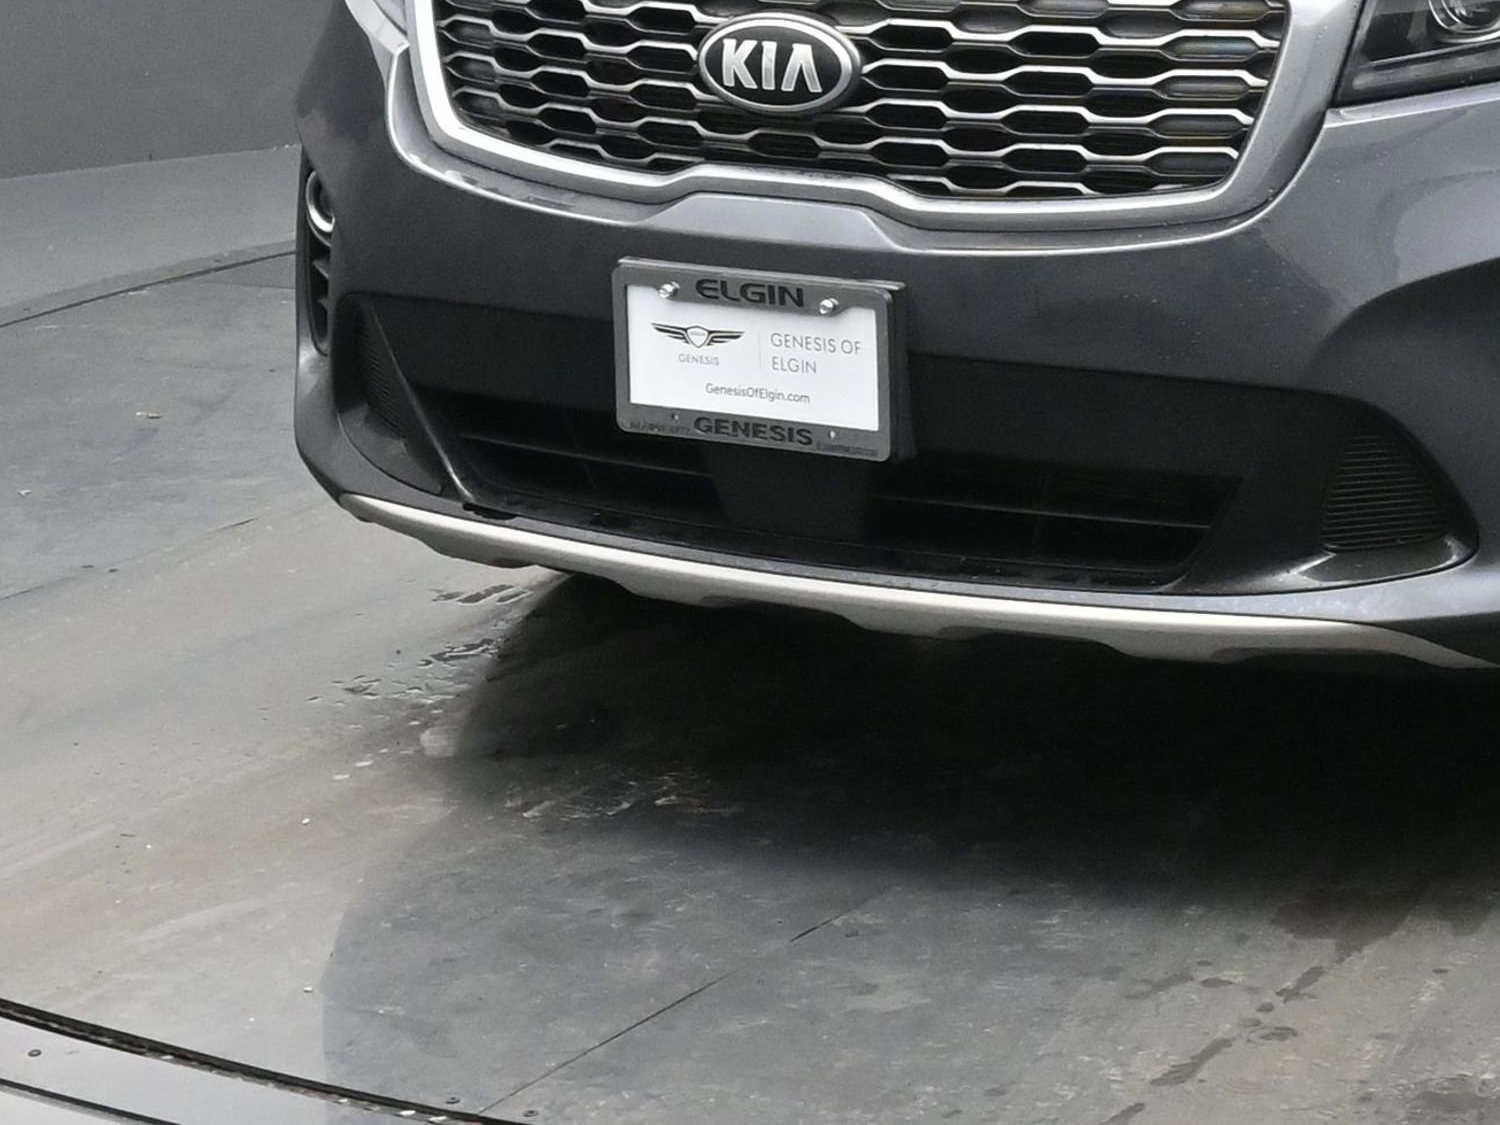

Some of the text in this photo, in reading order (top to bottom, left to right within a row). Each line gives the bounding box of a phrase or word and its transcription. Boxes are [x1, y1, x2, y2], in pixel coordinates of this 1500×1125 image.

[722, 38, 823, 94] KIA
[695, 278, 805, 308] ELGIN
[769, 332, 862, 355] GENESIS OF
[678, 352, 720, 367] GENESIS
[771, 358, 818, 375] ELGIN
[705, 382, 811, 404] GenesisOfElgin.com
[693, 416, 814, 446] GENESIS
